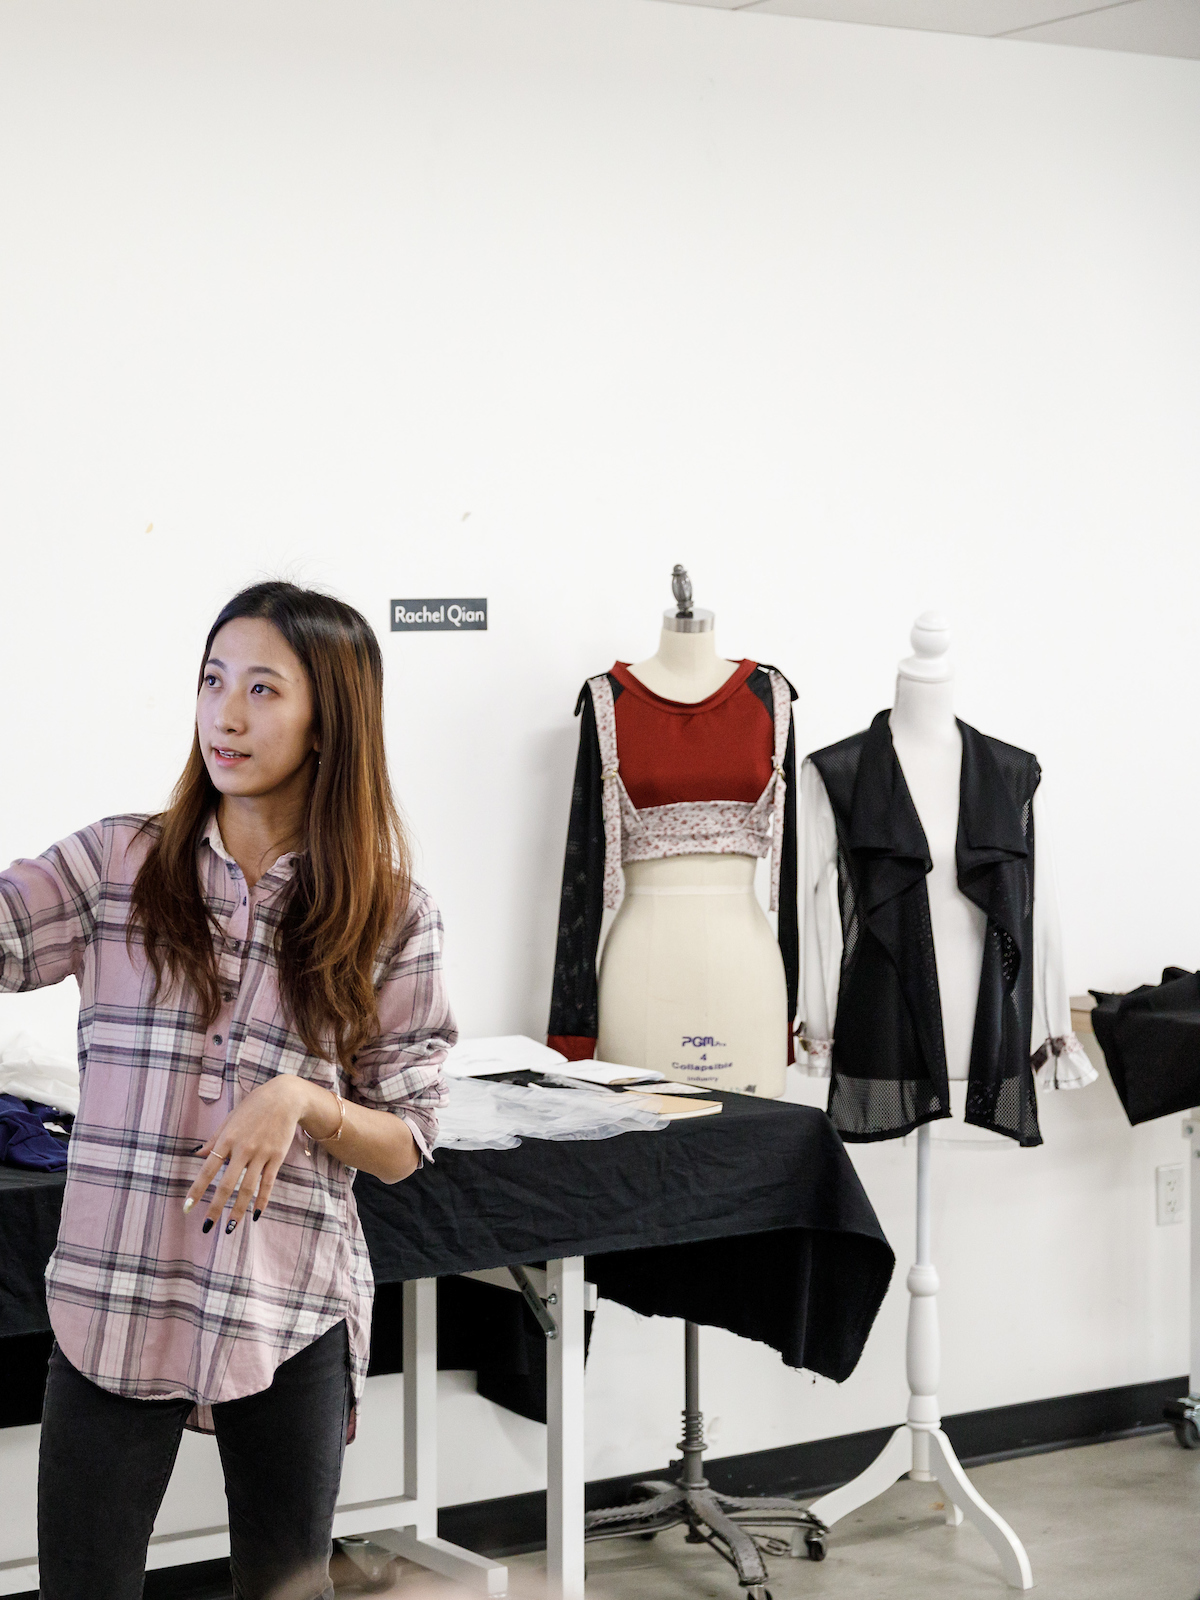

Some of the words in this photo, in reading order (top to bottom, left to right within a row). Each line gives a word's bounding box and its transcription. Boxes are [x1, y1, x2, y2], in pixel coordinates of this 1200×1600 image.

[394, 605, 445, 623] Rachel
[447, 604, 485, 627] Qian
[682, 1036, 714, 1047] PGM
[700, 1053, 707, 1061] 4
[671, 1061, 733, 1072] Collapsible
